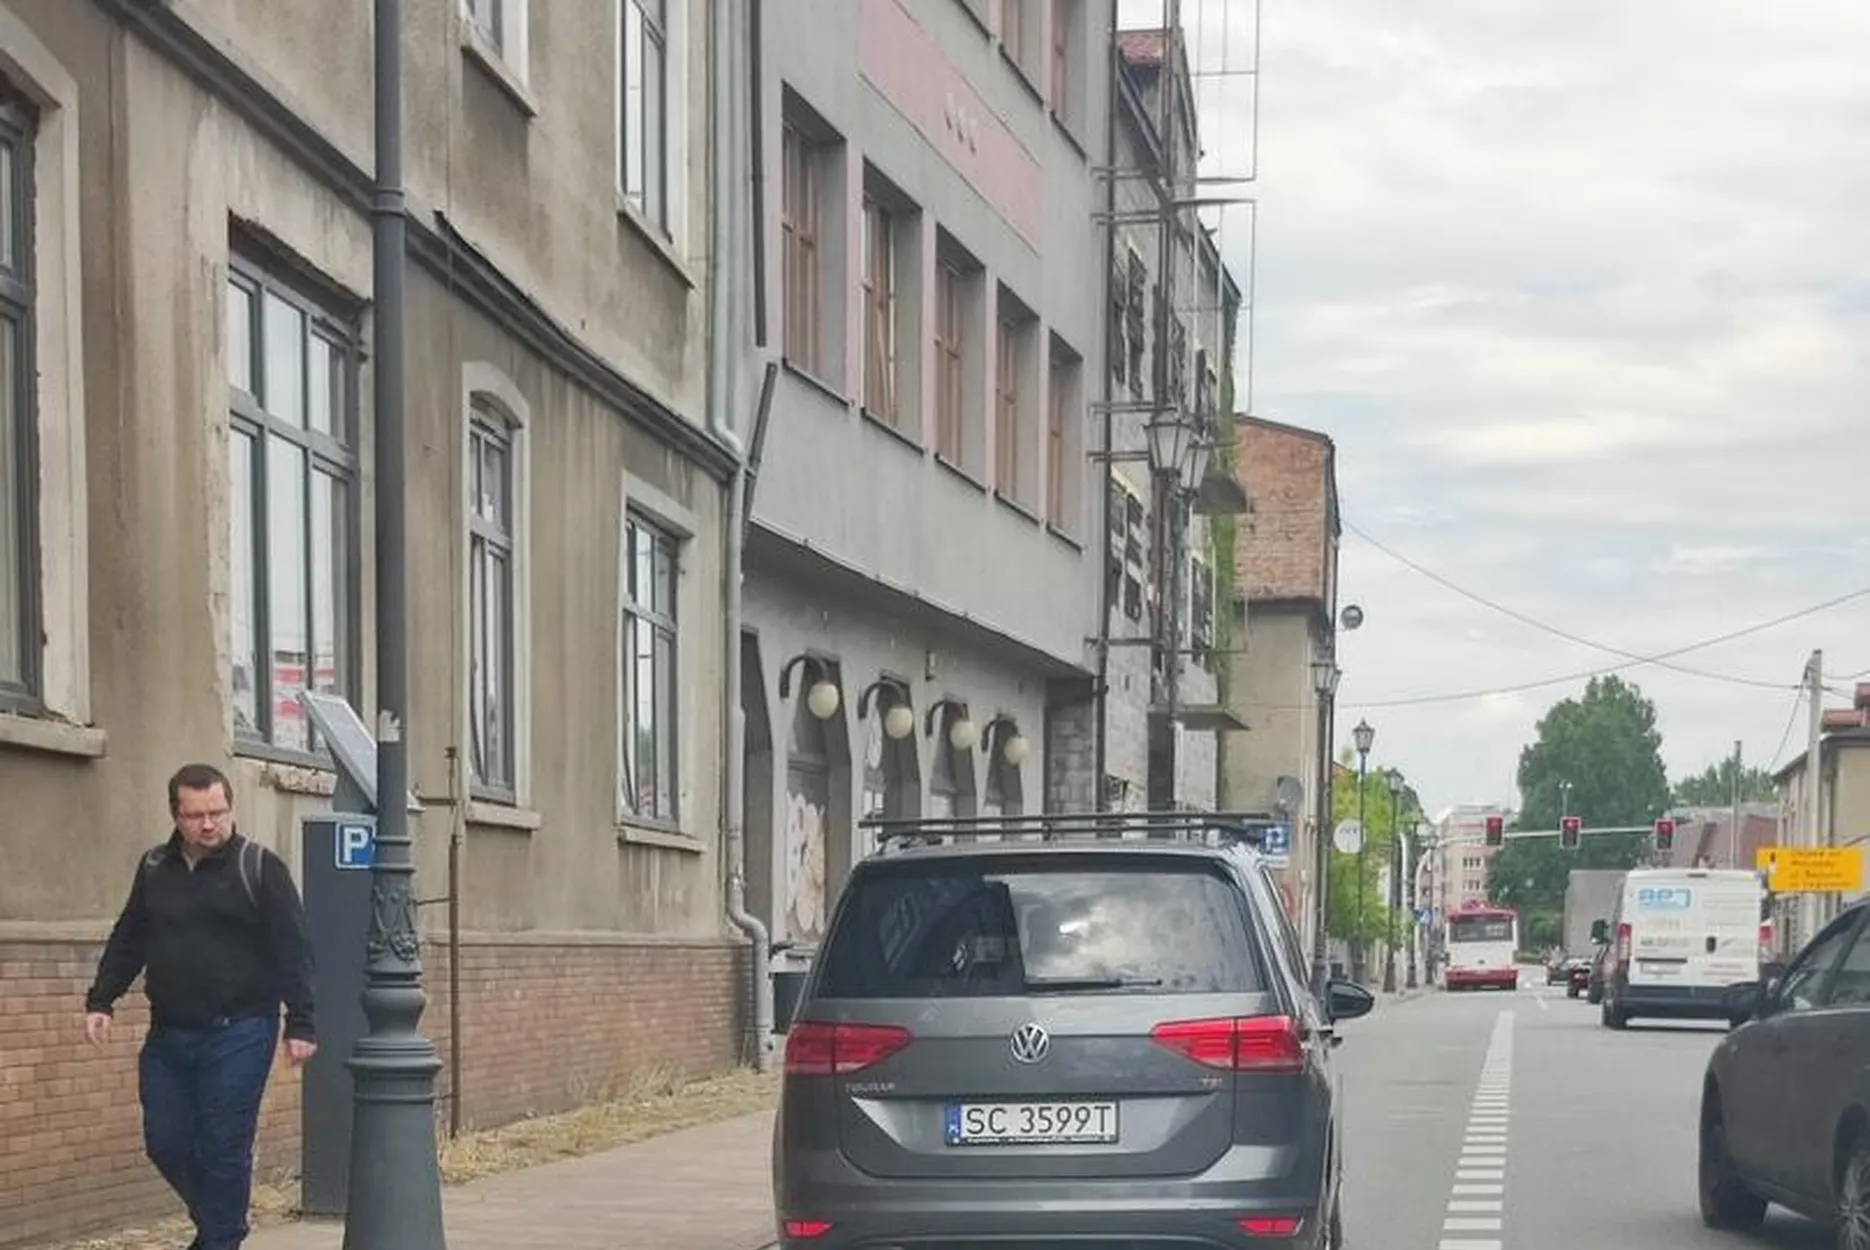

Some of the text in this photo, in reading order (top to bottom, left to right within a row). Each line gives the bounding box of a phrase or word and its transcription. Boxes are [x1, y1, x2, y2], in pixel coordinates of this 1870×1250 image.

[344, 828, 369, 861] P
[966, 1105, 1111, 1135] SC 3599T
